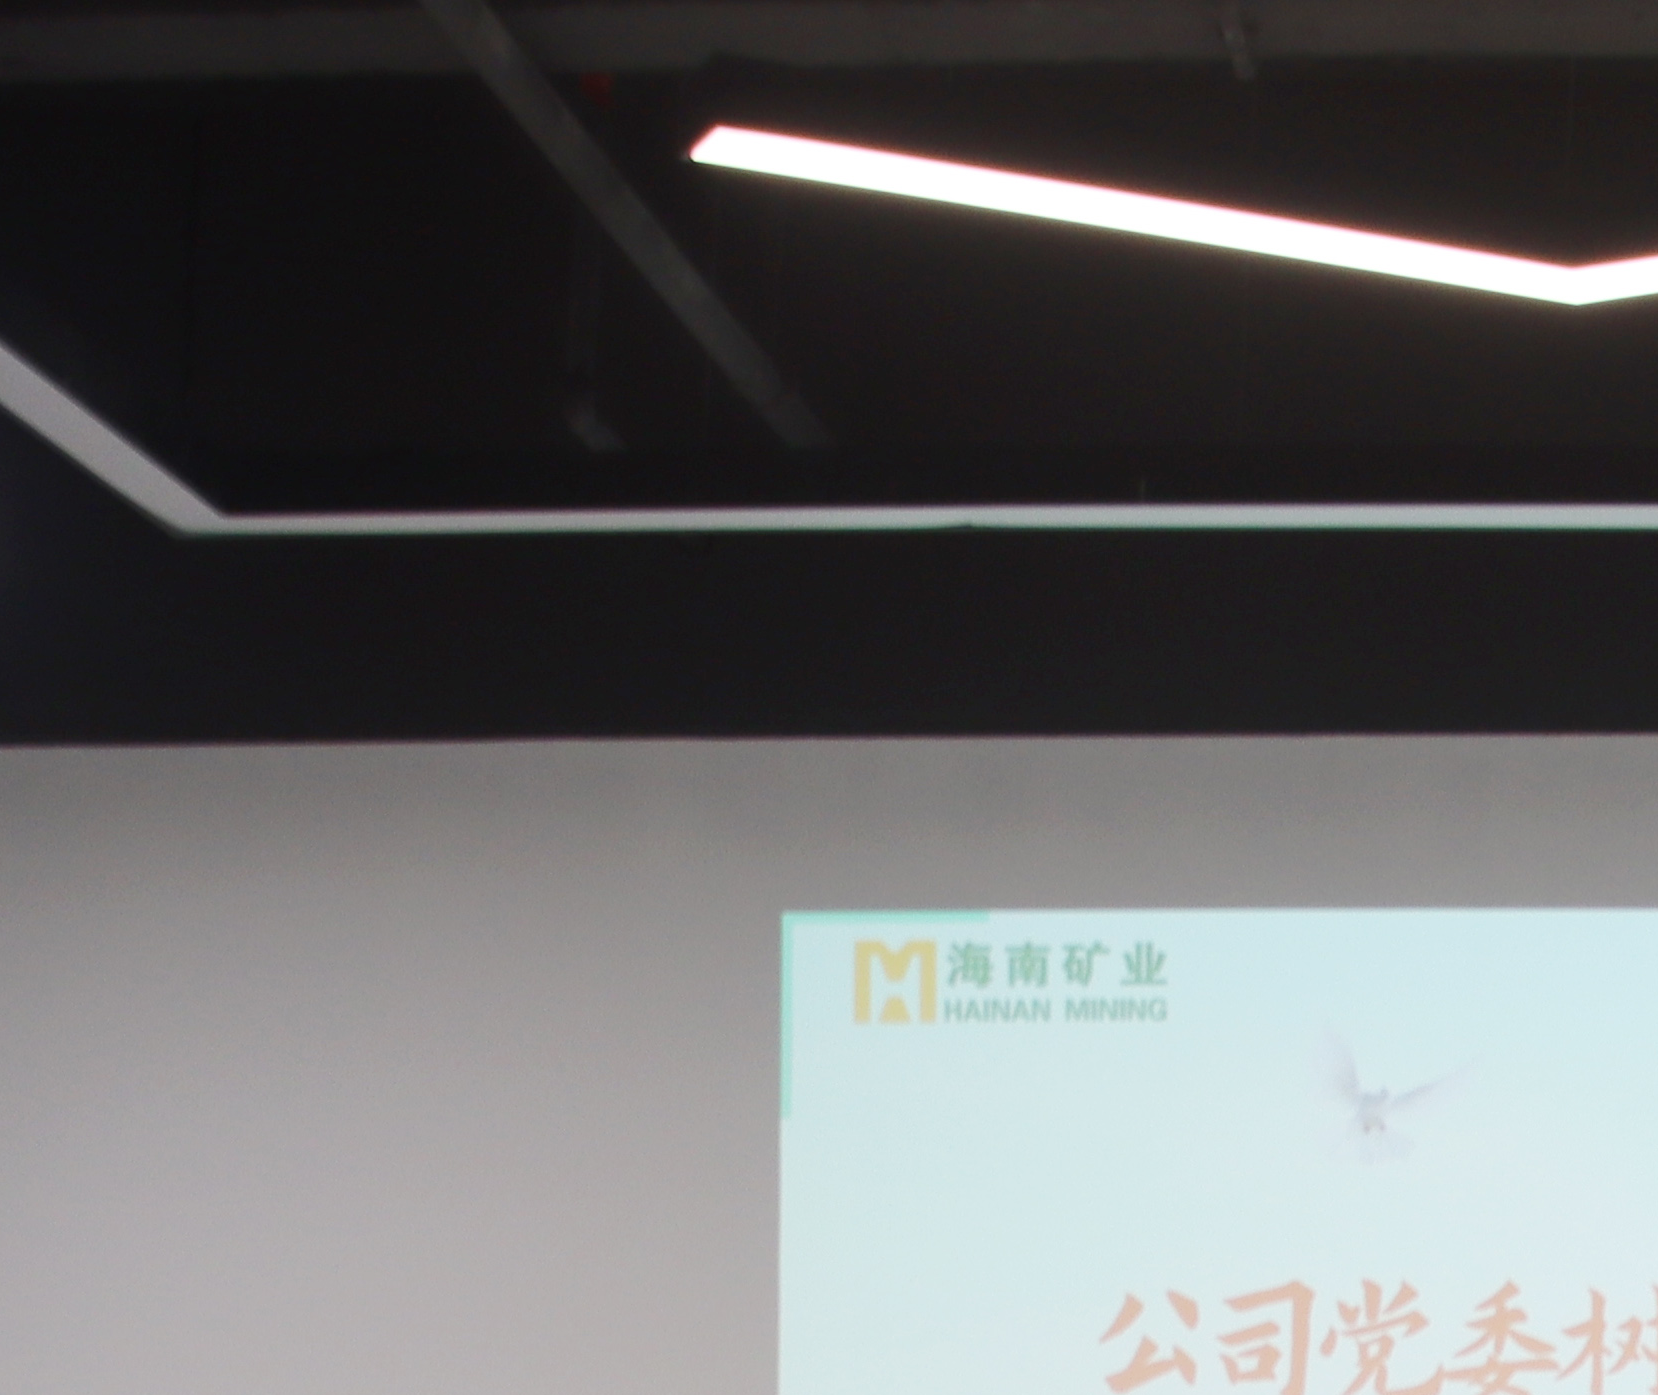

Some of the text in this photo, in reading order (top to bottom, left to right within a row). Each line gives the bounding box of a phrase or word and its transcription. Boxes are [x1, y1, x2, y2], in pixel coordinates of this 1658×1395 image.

[946, 940, 1169, 989] 海南矿业
[944, 998, 1169, 1023] HAINAN MINING
